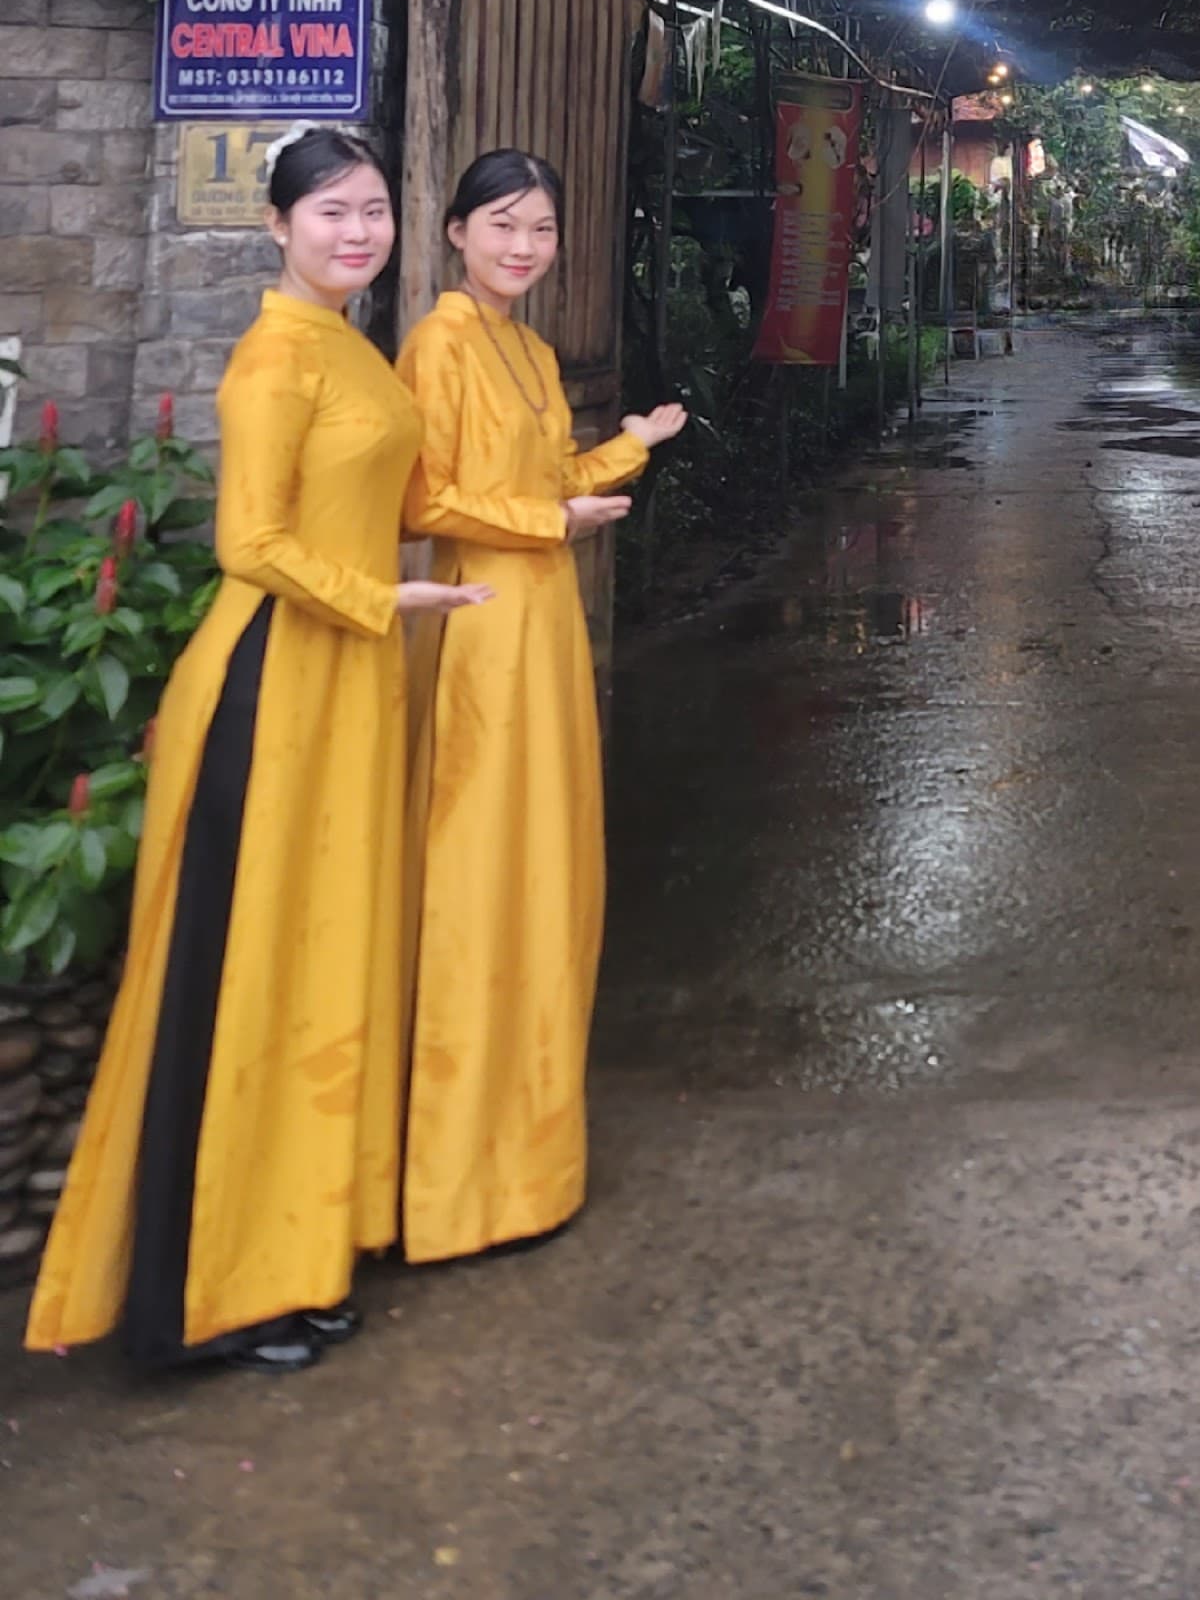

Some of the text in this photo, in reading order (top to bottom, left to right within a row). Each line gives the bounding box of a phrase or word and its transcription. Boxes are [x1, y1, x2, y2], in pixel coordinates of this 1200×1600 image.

[171, 23, 355, 58] CENTRAL VINA
[178, 69, 345, 87] MST: 0313186112
